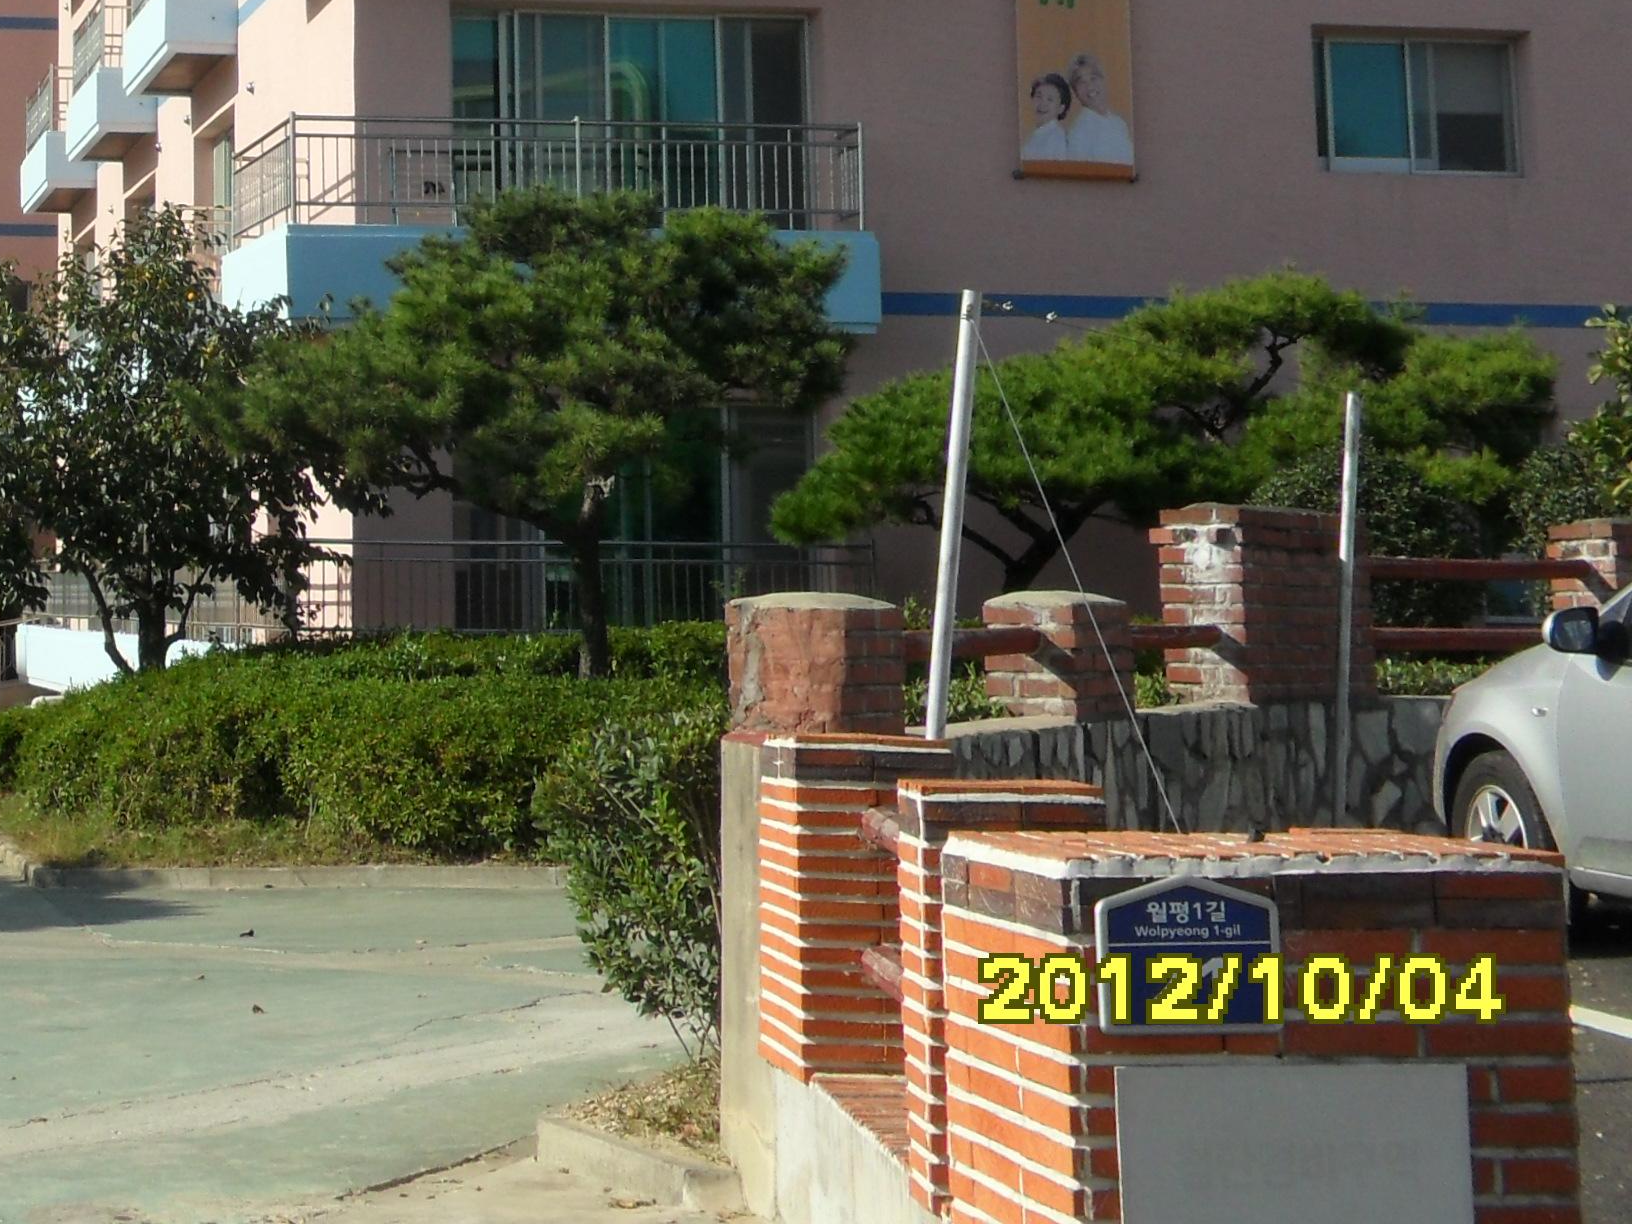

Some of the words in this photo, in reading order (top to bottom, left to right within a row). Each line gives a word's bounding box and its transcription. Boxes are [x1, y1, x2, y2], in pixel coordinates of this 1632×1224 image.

[1146, 900, 1226, 924] 월평1길
[1134, 925, 1210, 939] Wolpyeong
[1214, 924, 1241, 939] 1-gil
